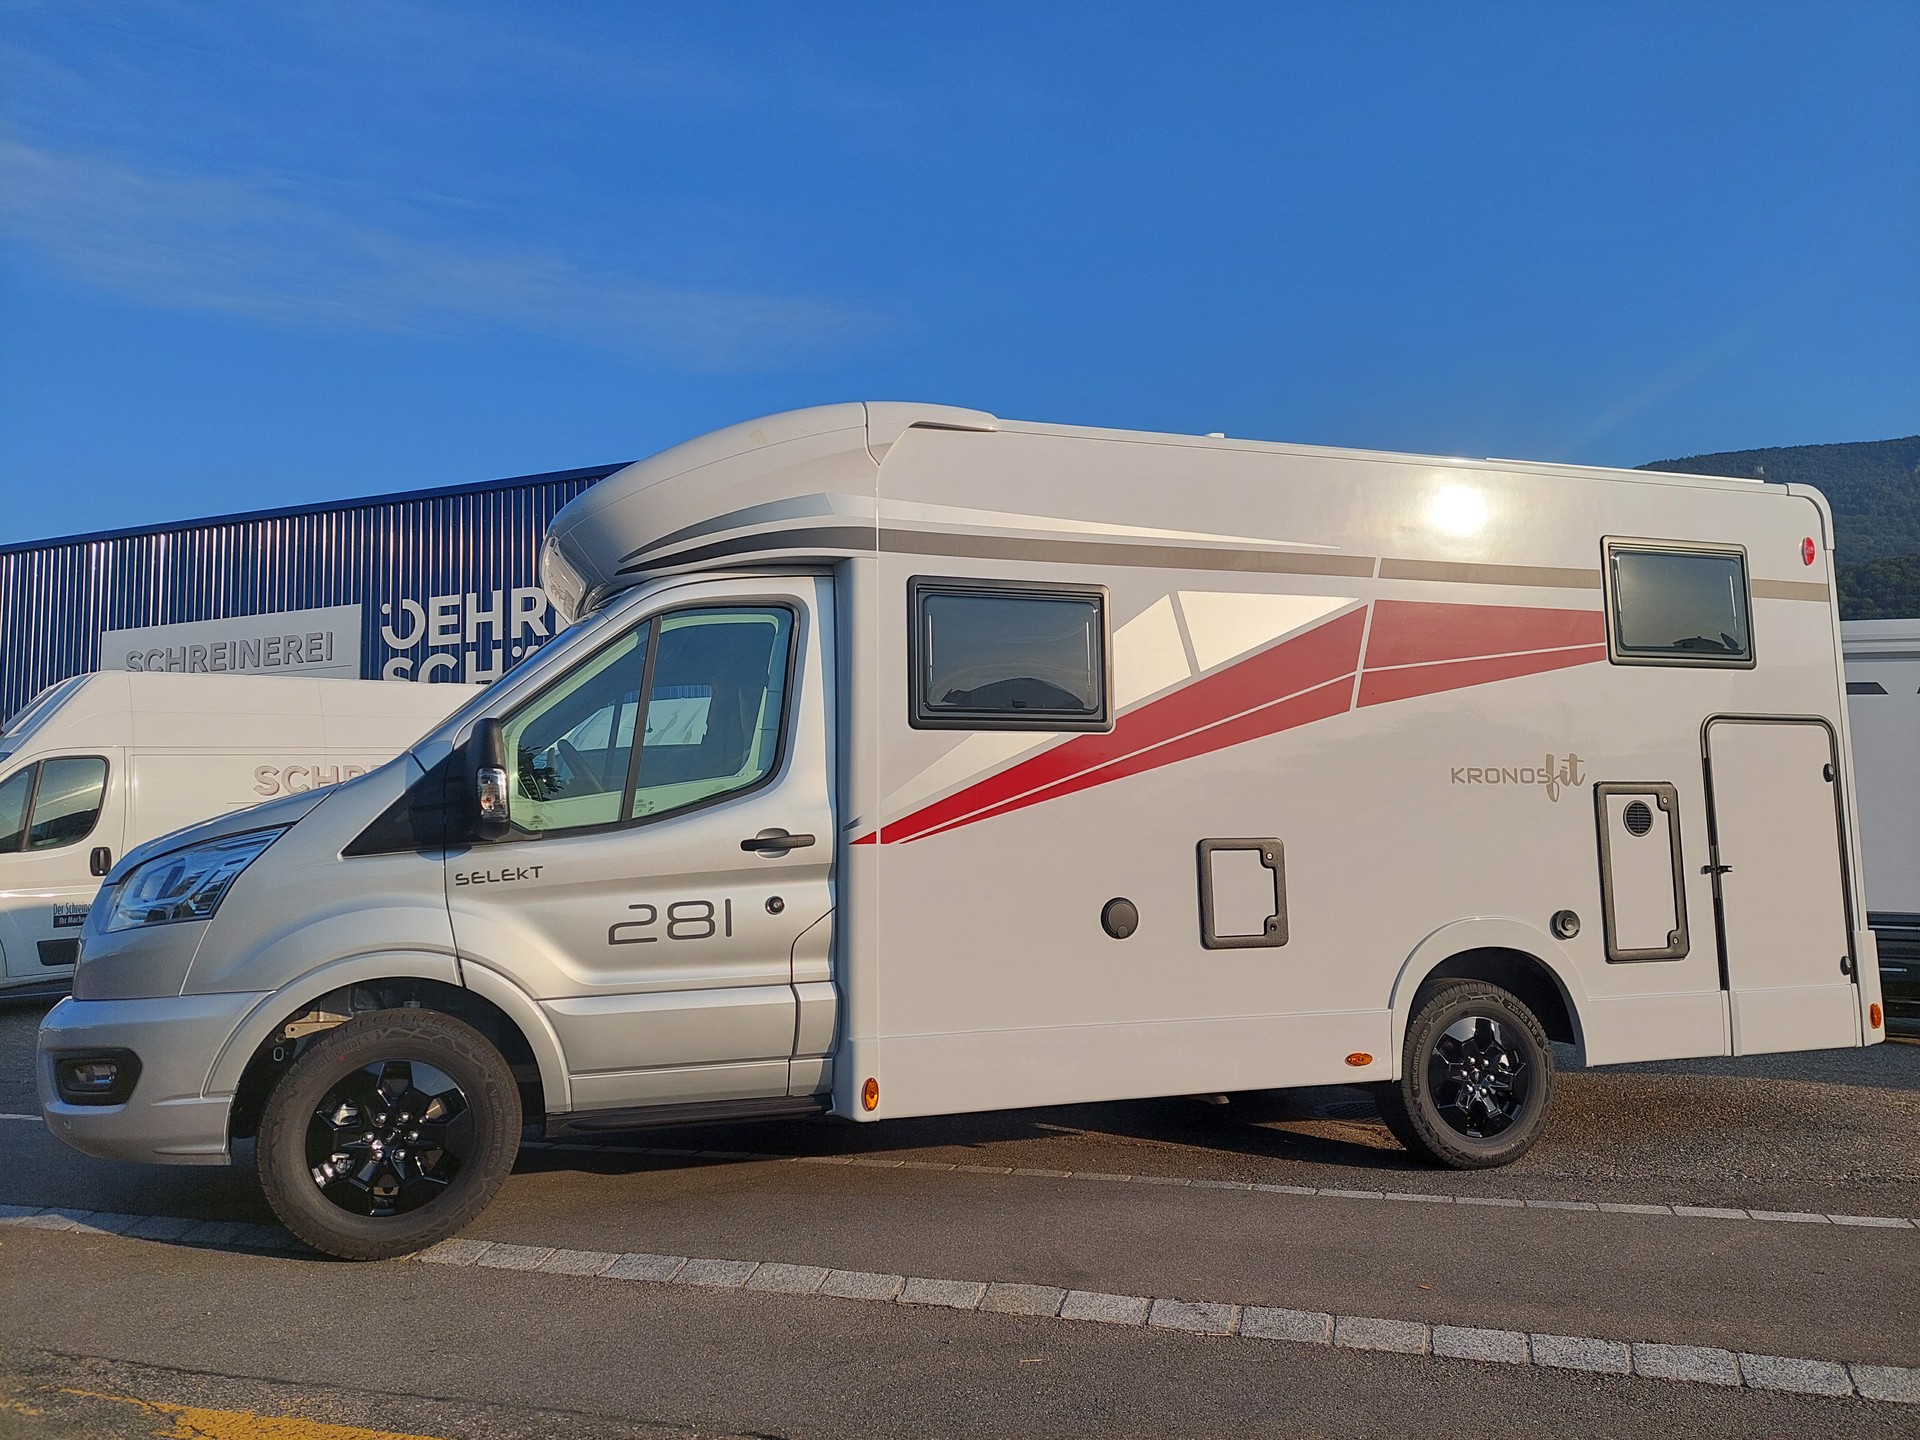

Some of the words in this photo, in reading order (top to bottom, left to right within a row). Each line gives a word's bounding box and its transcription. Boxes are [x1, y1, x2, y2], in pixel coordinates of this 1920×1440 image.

[126, 631, 333, 674] SCHREINEREI
[53, 902, 64, 915] Der
[65, 901, 92, 914] Schreine
[67, 915, 86, 924] Mache
[608, 898, 733, 946] 281
